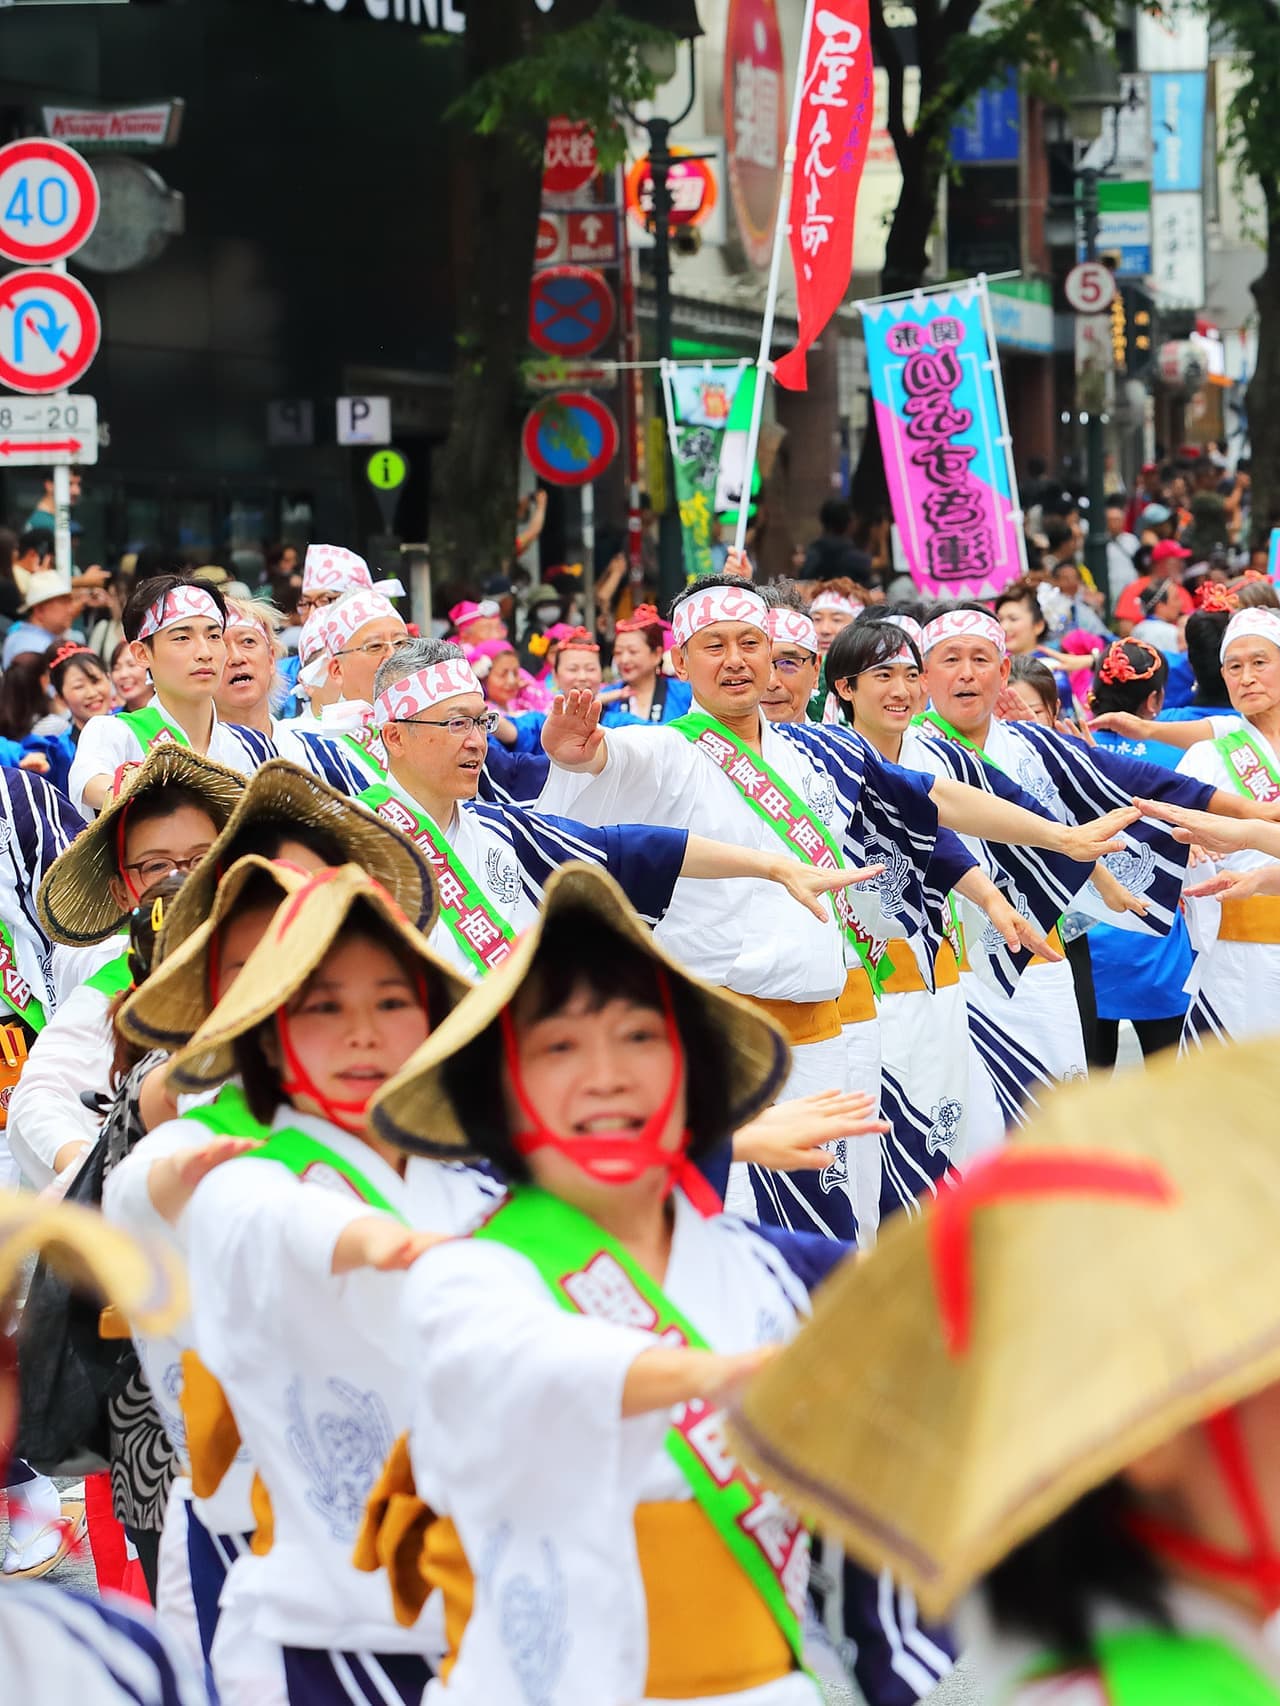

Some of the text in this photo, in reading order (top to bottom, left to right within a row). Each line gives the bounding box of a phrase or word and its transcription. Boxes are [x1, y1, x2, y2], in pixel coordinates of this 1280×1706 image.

[5, 176, 68, 227] 40
[1079, 271, 1102, 304] 5
[351, 398, 370, 432] P
